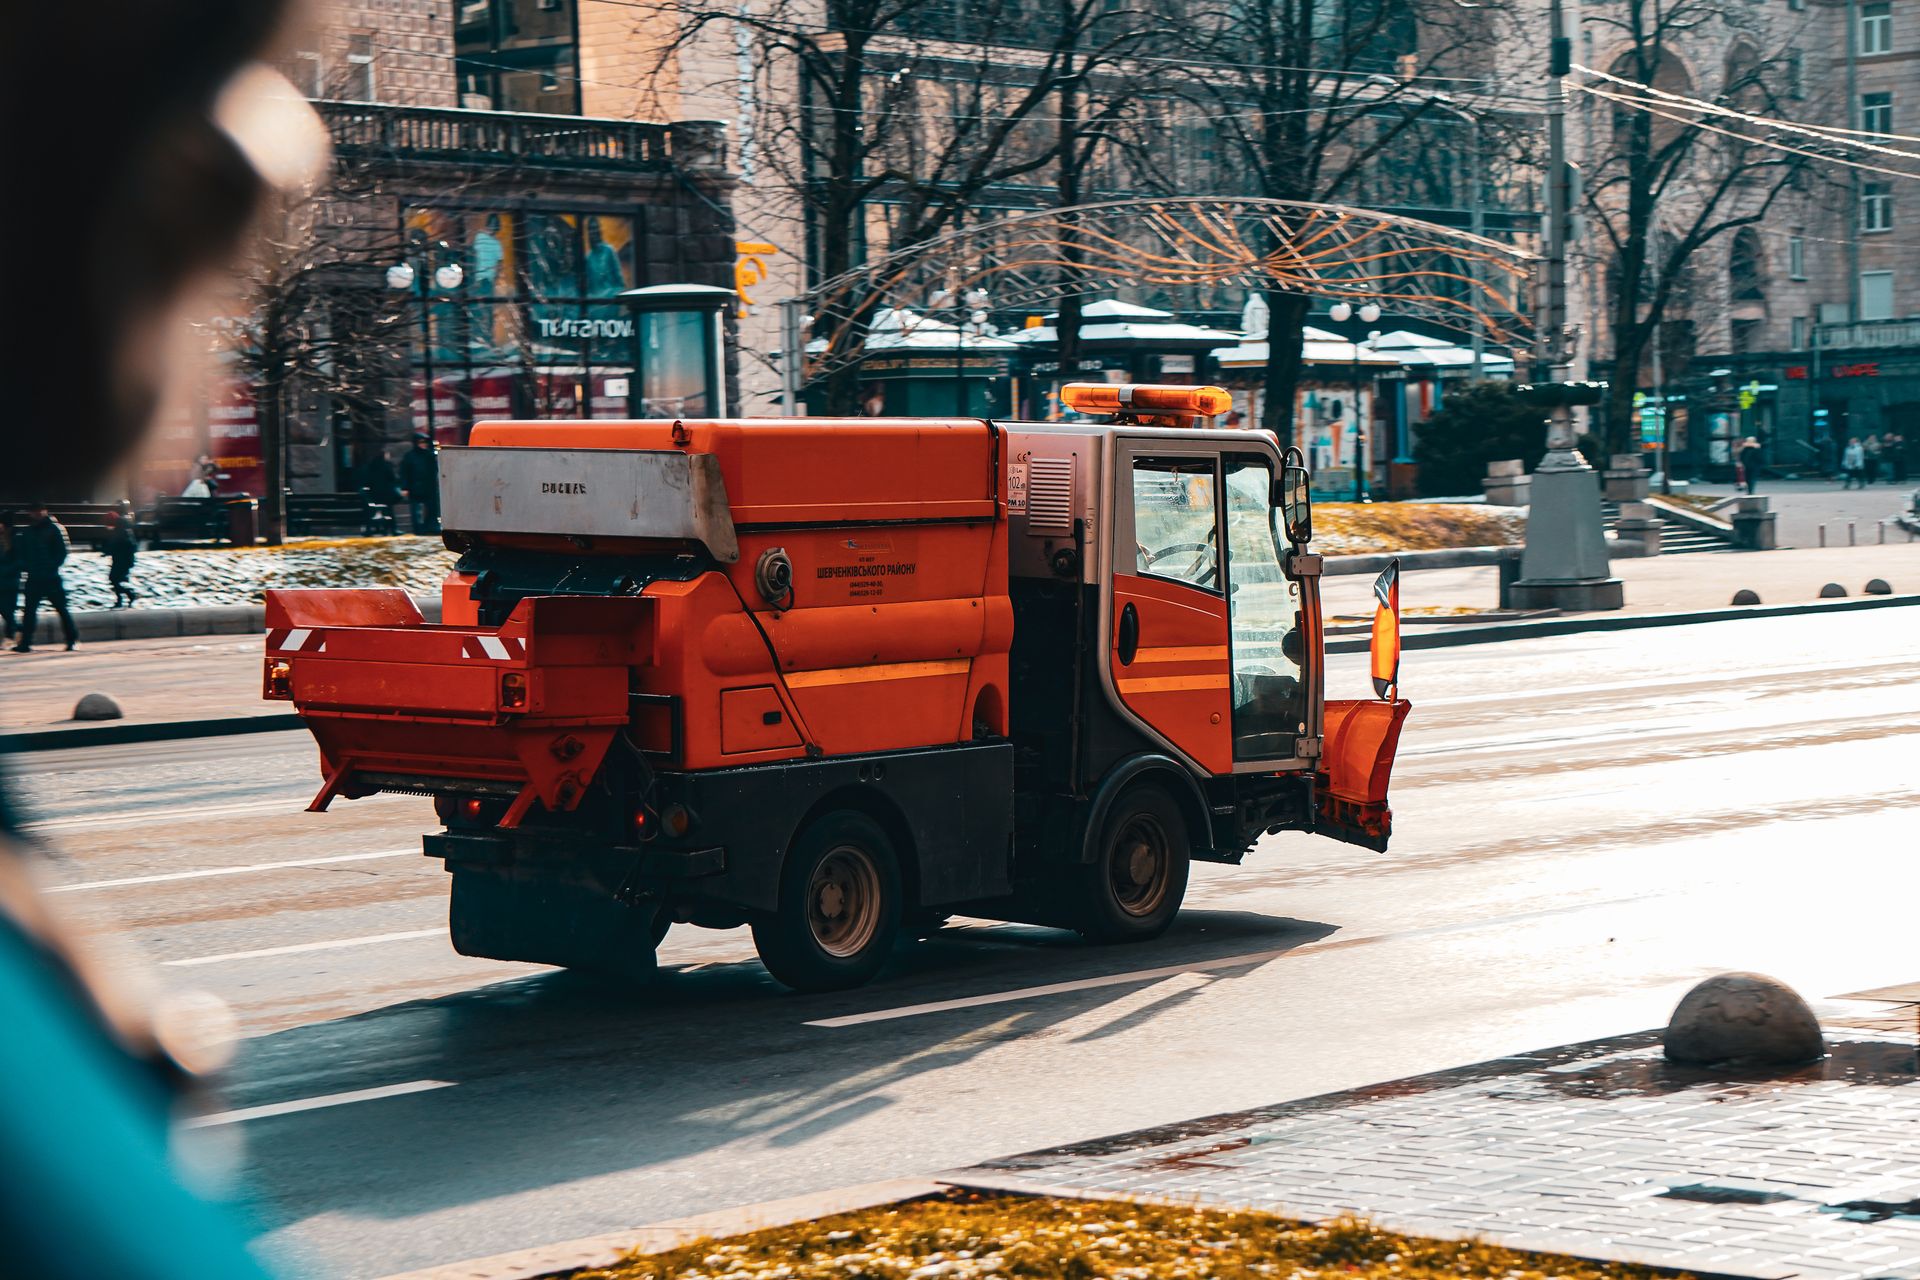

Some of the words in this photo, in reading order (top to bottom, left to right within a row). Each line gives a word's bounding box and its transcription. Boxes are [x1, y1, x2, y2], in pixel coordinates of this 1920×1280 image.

[1009, 476, 1021, 489] 102
[817, 565, 886, 579] ШЕВЧЕНКІВСЬКОГО
[887, 561, 916, 576] РАЙОНУ
